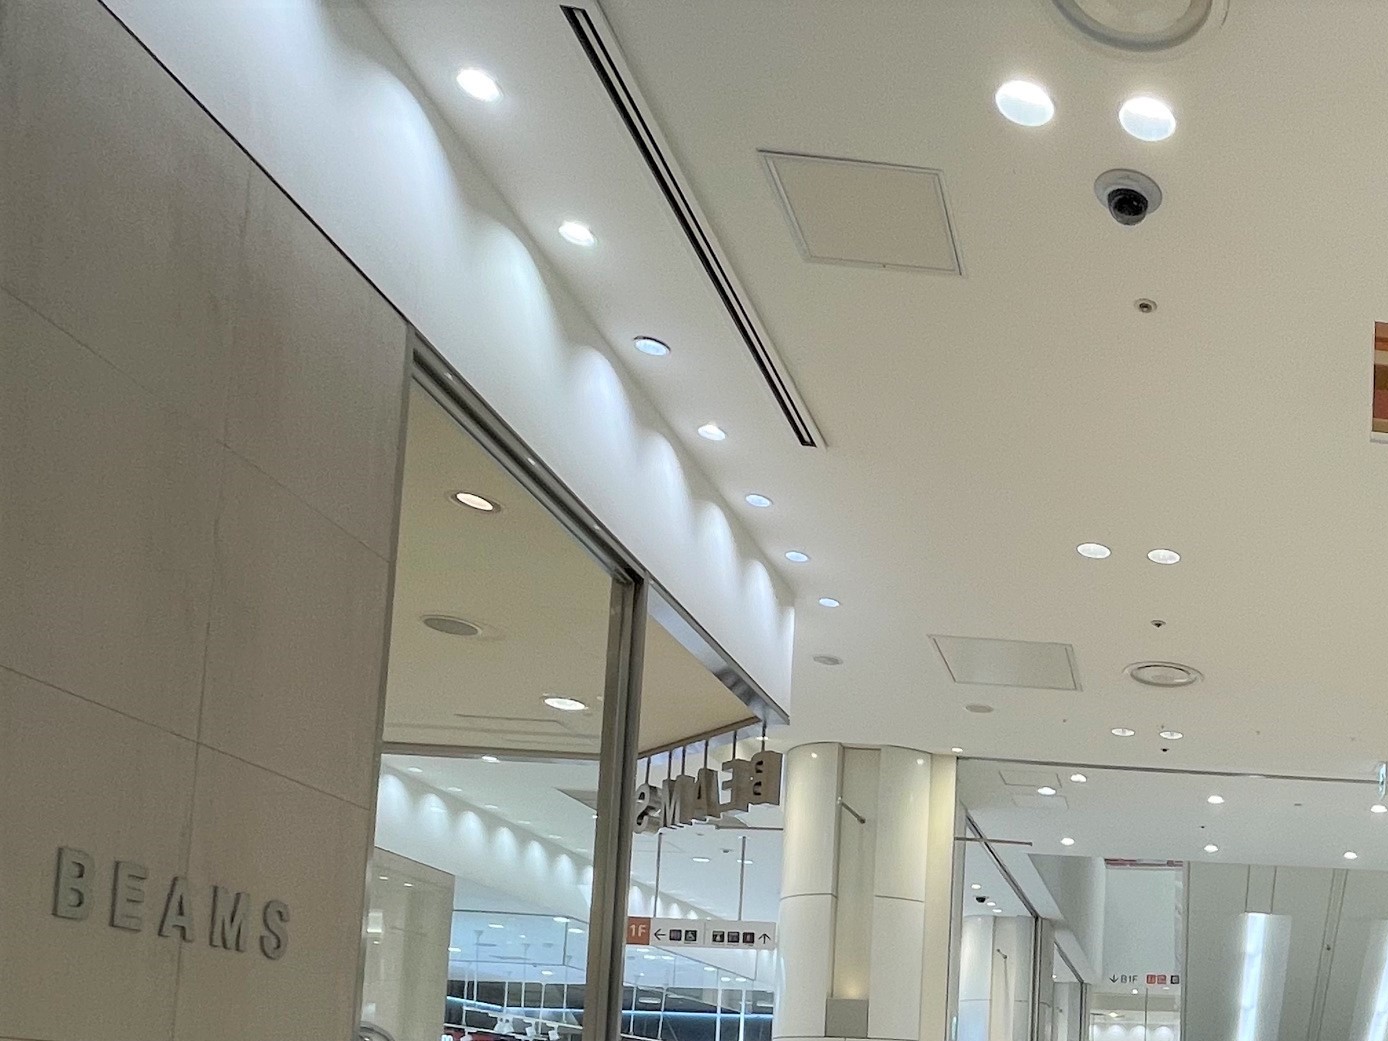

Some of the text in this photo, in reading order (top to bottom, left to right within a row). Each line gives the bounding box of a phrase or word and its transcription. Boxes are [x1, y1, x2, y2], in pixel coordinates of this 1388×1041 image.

[51, 845, 291, 961] BEAMS
[629, 924, 647, 938] 1F
[1120, 974, 1139, 984] B1F
